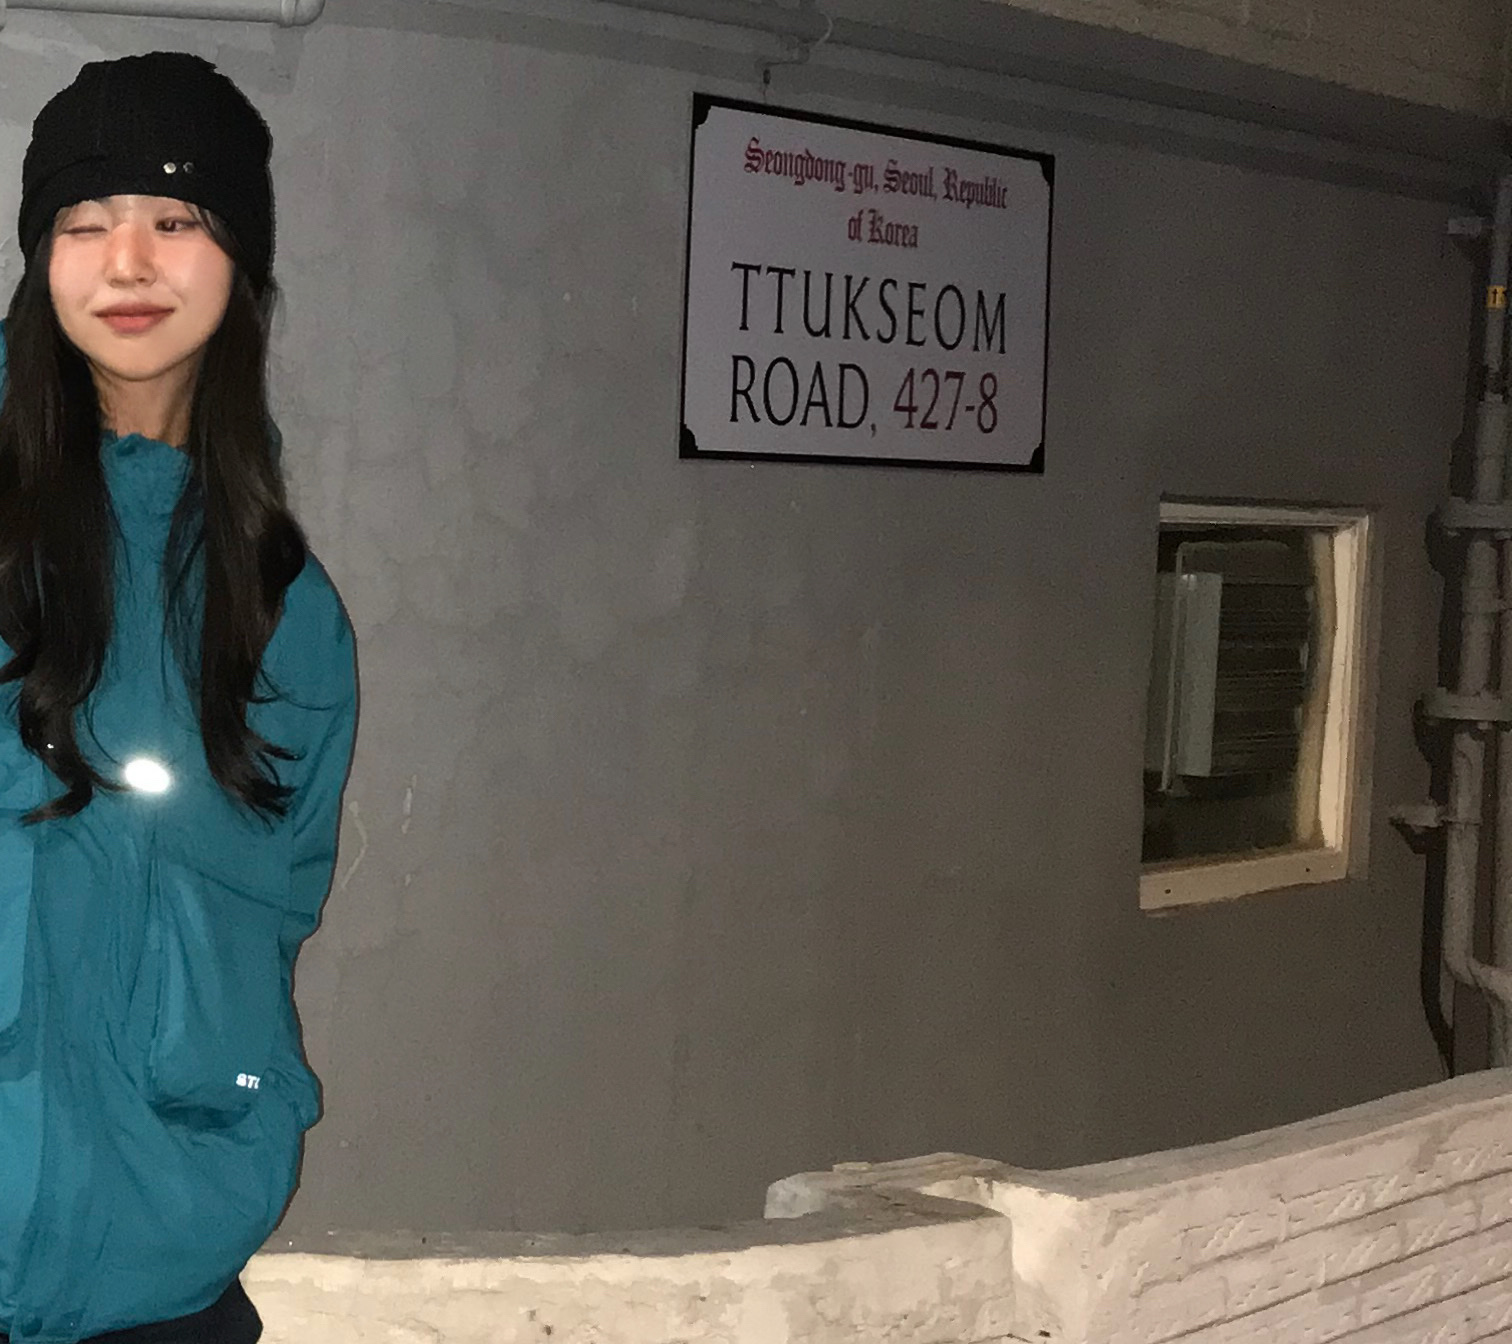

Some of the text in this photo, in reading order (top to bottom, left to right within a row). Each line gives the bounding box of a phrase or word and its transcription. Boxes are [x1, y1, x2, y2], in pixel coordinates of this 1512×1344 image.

[883, 159, 937, 200] Seoul,
[943, 167, 1008, 209] Republic
[848, 208, 919, 248] of Korea
[731, 261, 1007, 354] TTUKSEOM
[729, 355, 998, 437] ROAD, 427-8
